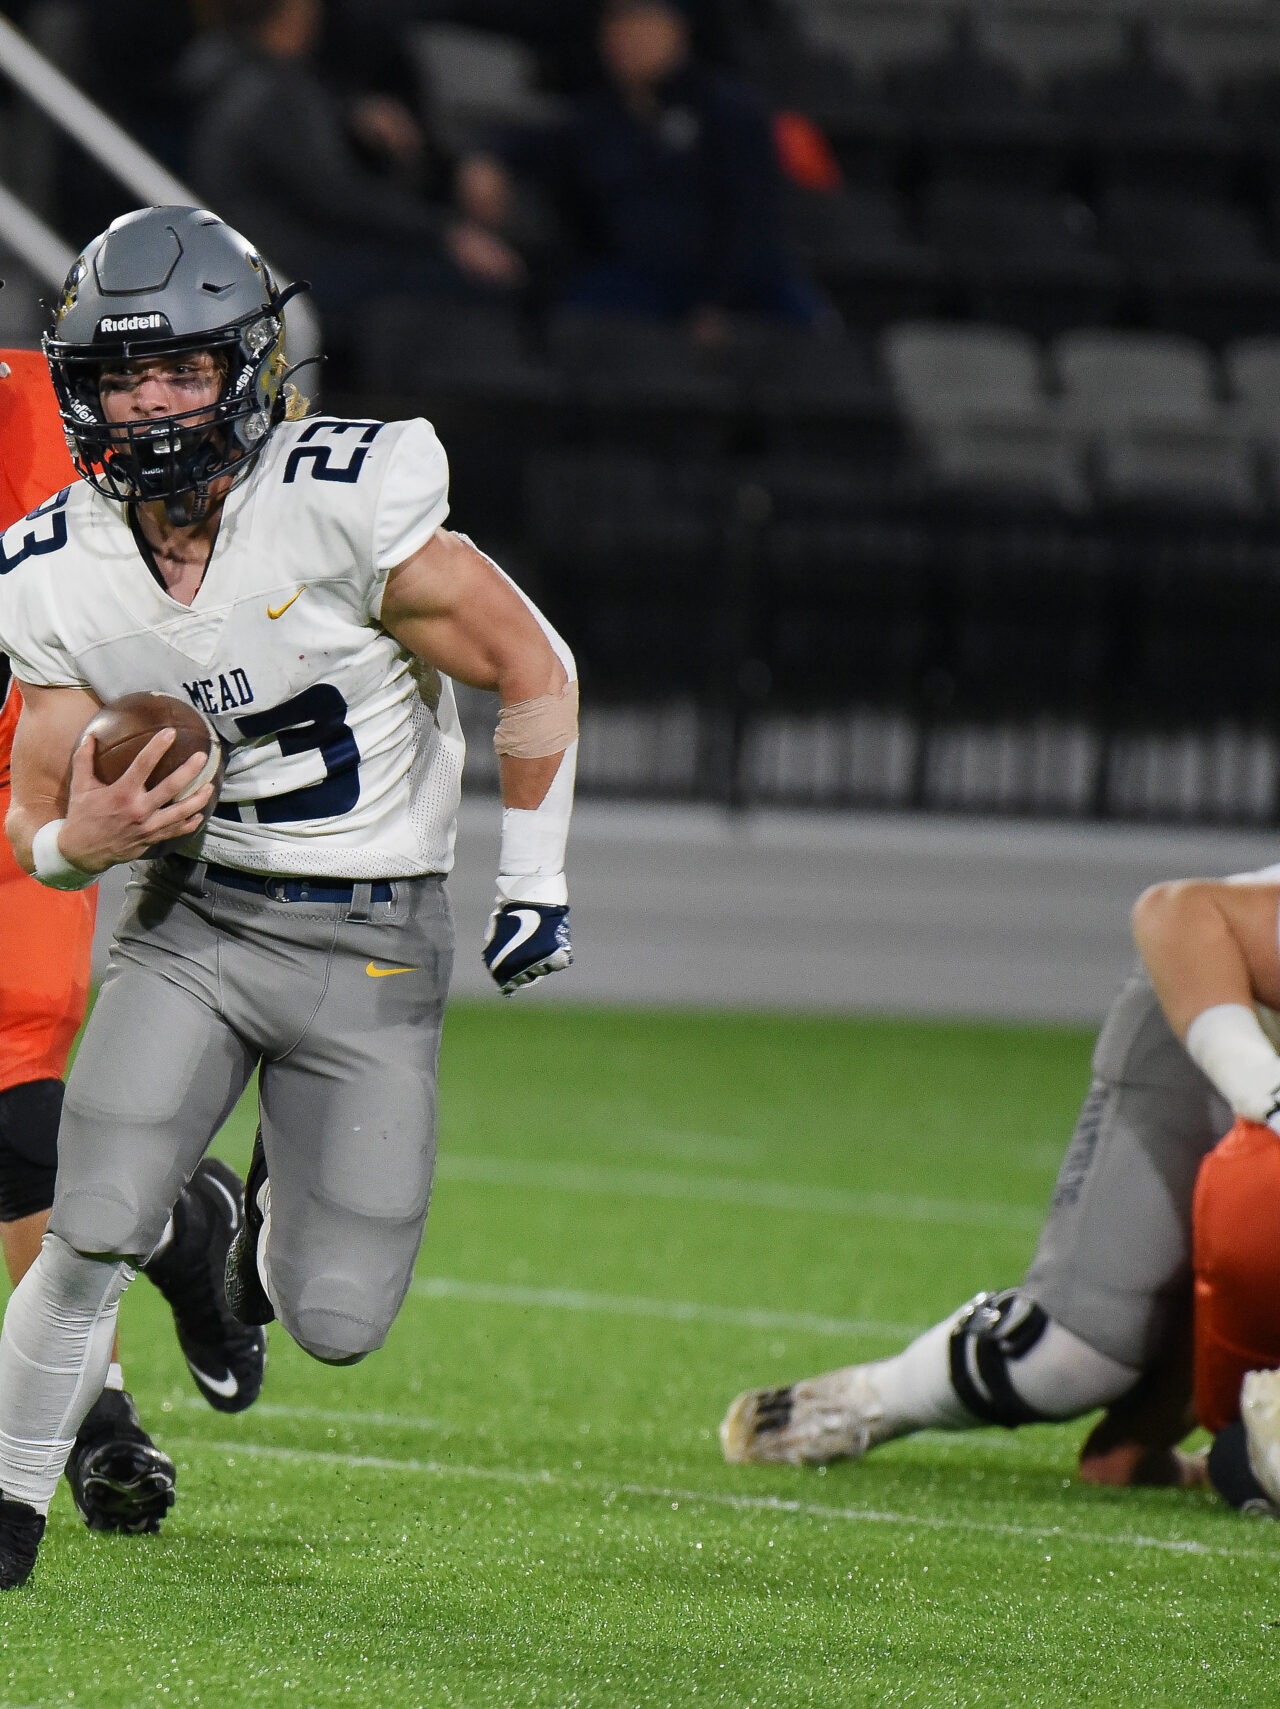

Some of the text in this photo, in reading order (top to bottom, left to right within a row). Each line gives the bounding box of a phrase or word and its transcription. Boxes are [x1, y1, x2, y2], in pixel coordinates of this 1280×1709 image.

[100, 314, 161, 333] Riddell
[282, 420, 386, 484] 23
[182, 667, 255, 715] MEAD
[213, 682, 361, 824] 3
